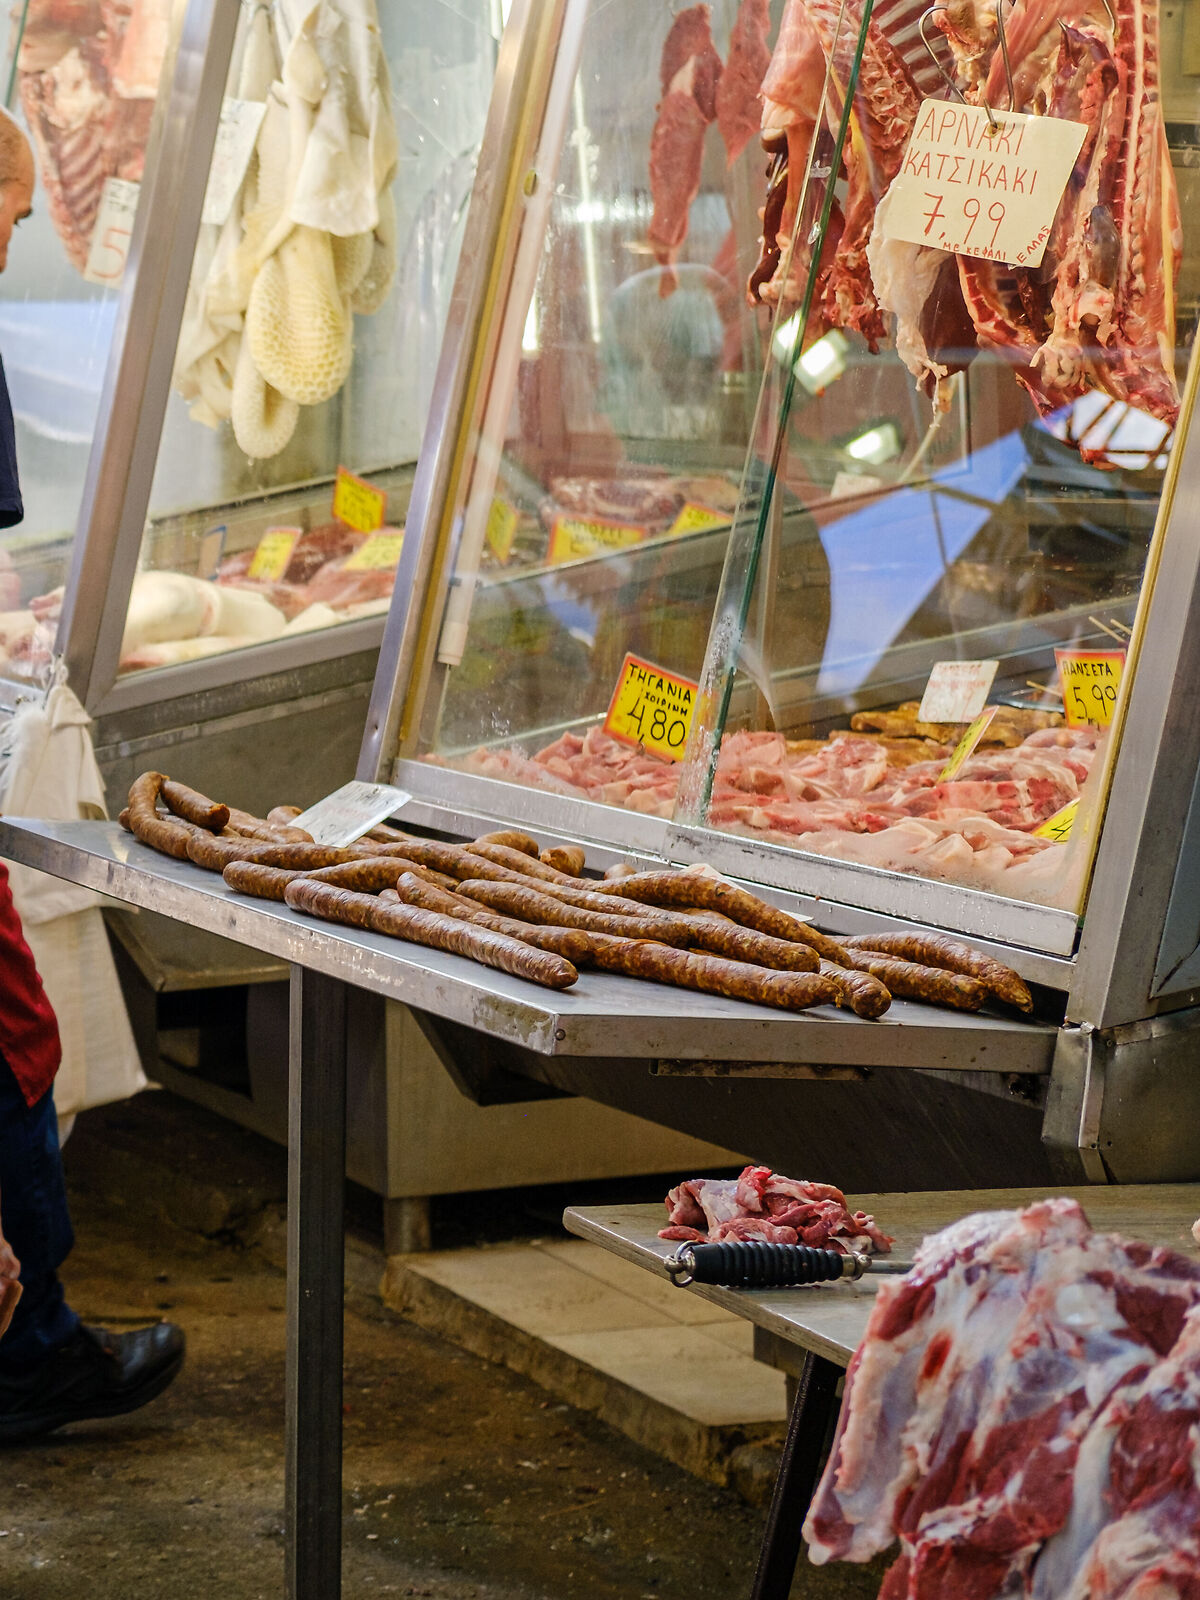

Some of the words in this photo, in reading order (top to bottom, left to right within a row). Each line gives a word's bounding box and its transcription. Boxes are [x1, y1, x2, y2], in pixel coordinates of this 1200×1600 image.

[917, 107, 1026, 156] ΑΡΝΑΚΙ
[903, 147, 1038, 195] ΚΑΤΣΙΚΑΚΙ
[922, 192, 1006, 248] 7,99
[966, 246, 1007, 261] ΚΕΦΑΛΙ
[629, 663, 691, 704] ΤΗΓΑΝΙΑ
[1062, 661, 1113, 677] ΠΑΝΣΕΤΑ
[627, 696, 686, 747] 4,80
